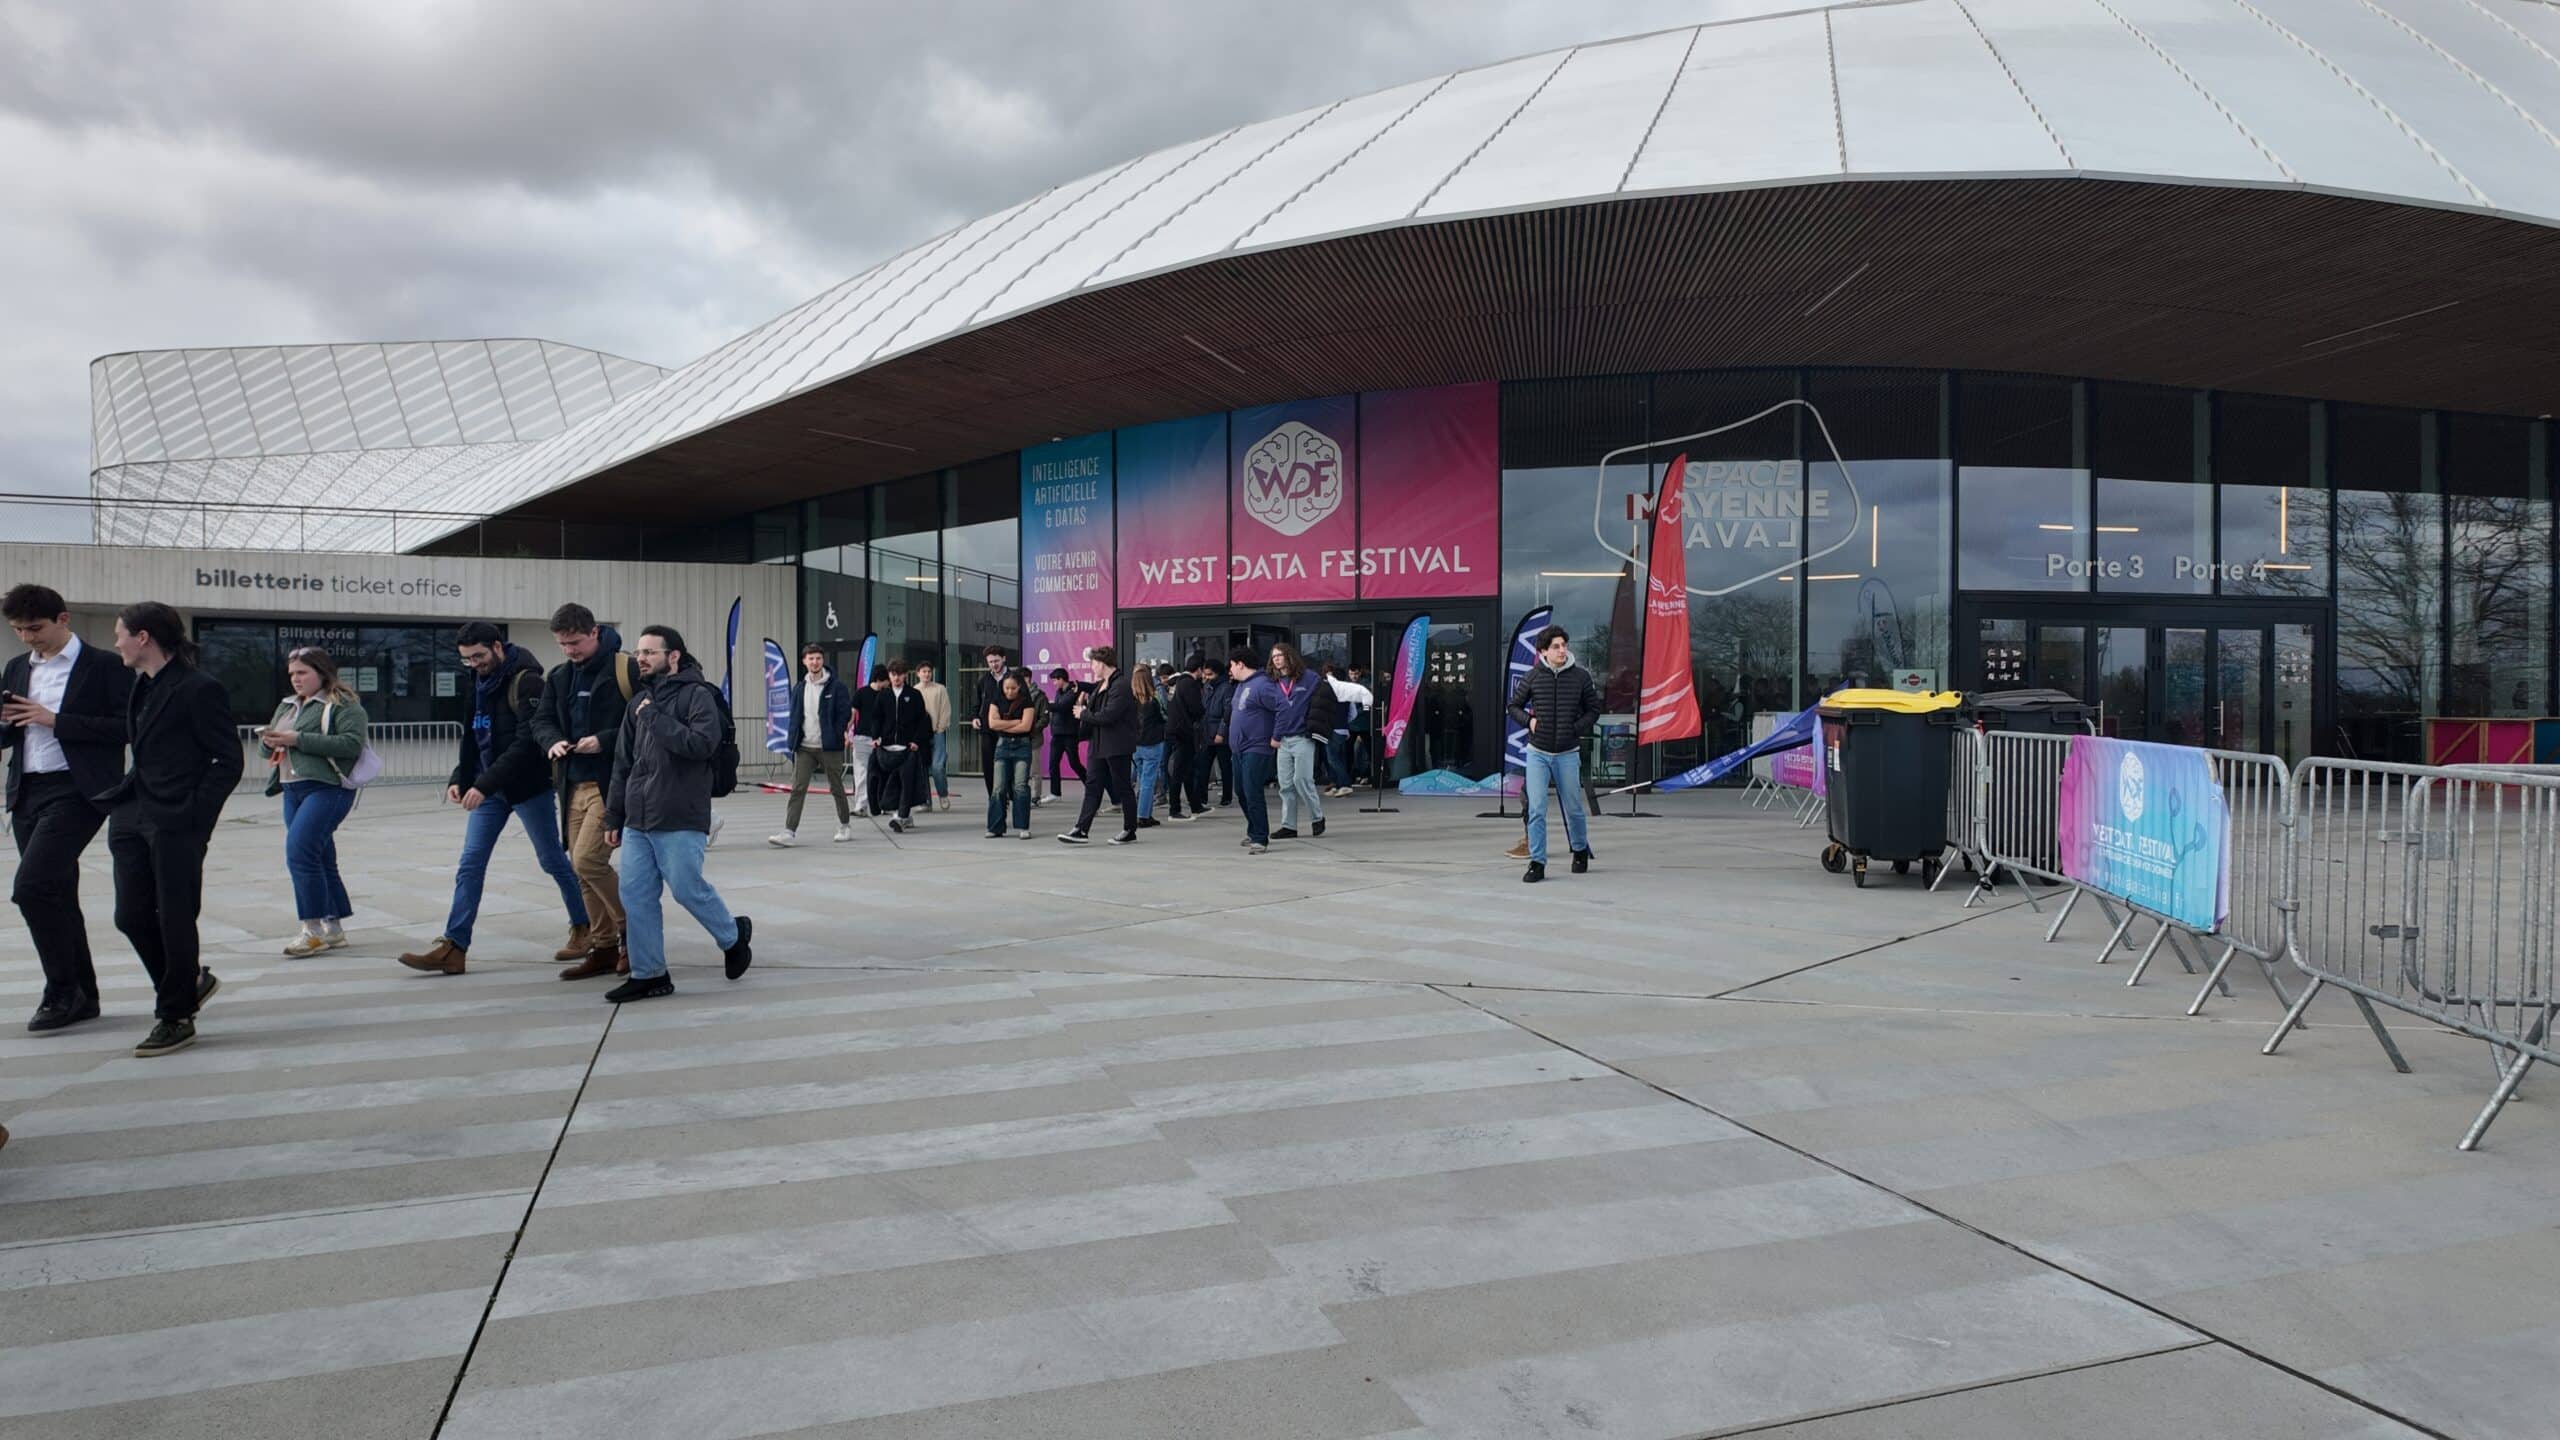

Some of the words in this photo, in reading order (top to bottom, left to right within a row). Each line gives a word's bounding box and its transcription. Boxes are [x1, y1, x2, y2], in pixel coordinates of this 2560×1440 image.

[1032, 456, 1100, 482] INTELLIGENCE
[1252, 460, 1334, 500] WDF
[1664, 460, 1796, 488] SPACE
[1034, 481, 1097, 505] ARTIFICIELLE
[1045, 509, 1052, 528] &
[1055, 506, 1087, 528] DATAS
[1034, 553, 1063, 572] VOTRE
[1064, 550, 1097, 569] AVENIR
[1138, 556, 1218, 585] WEST
[1229, 553, 1307, 581] DATA
[1321, 545, 1471, 578] FESTIVAL
[2048, 554, 2122, 578] Porte
[2129, 555, 2144, 579] 3
[2174, 556, 2244, 580] Porte
[2251, 558, 2266, 581] 4
[195, 568, 324, 591] billetterie
[331, 575, 395, 595] ticket
[400, 578, 462, 598] office
[1033, 573, 1084, 593] COMMENCE
[1086, 572, 1099, 590] ICI
[278, 626, 356, 640] Billetterie
[1025, 619, 1110, 633] WESTDATAFESTIVAL.FR
[326, 644, 367, 657] office
